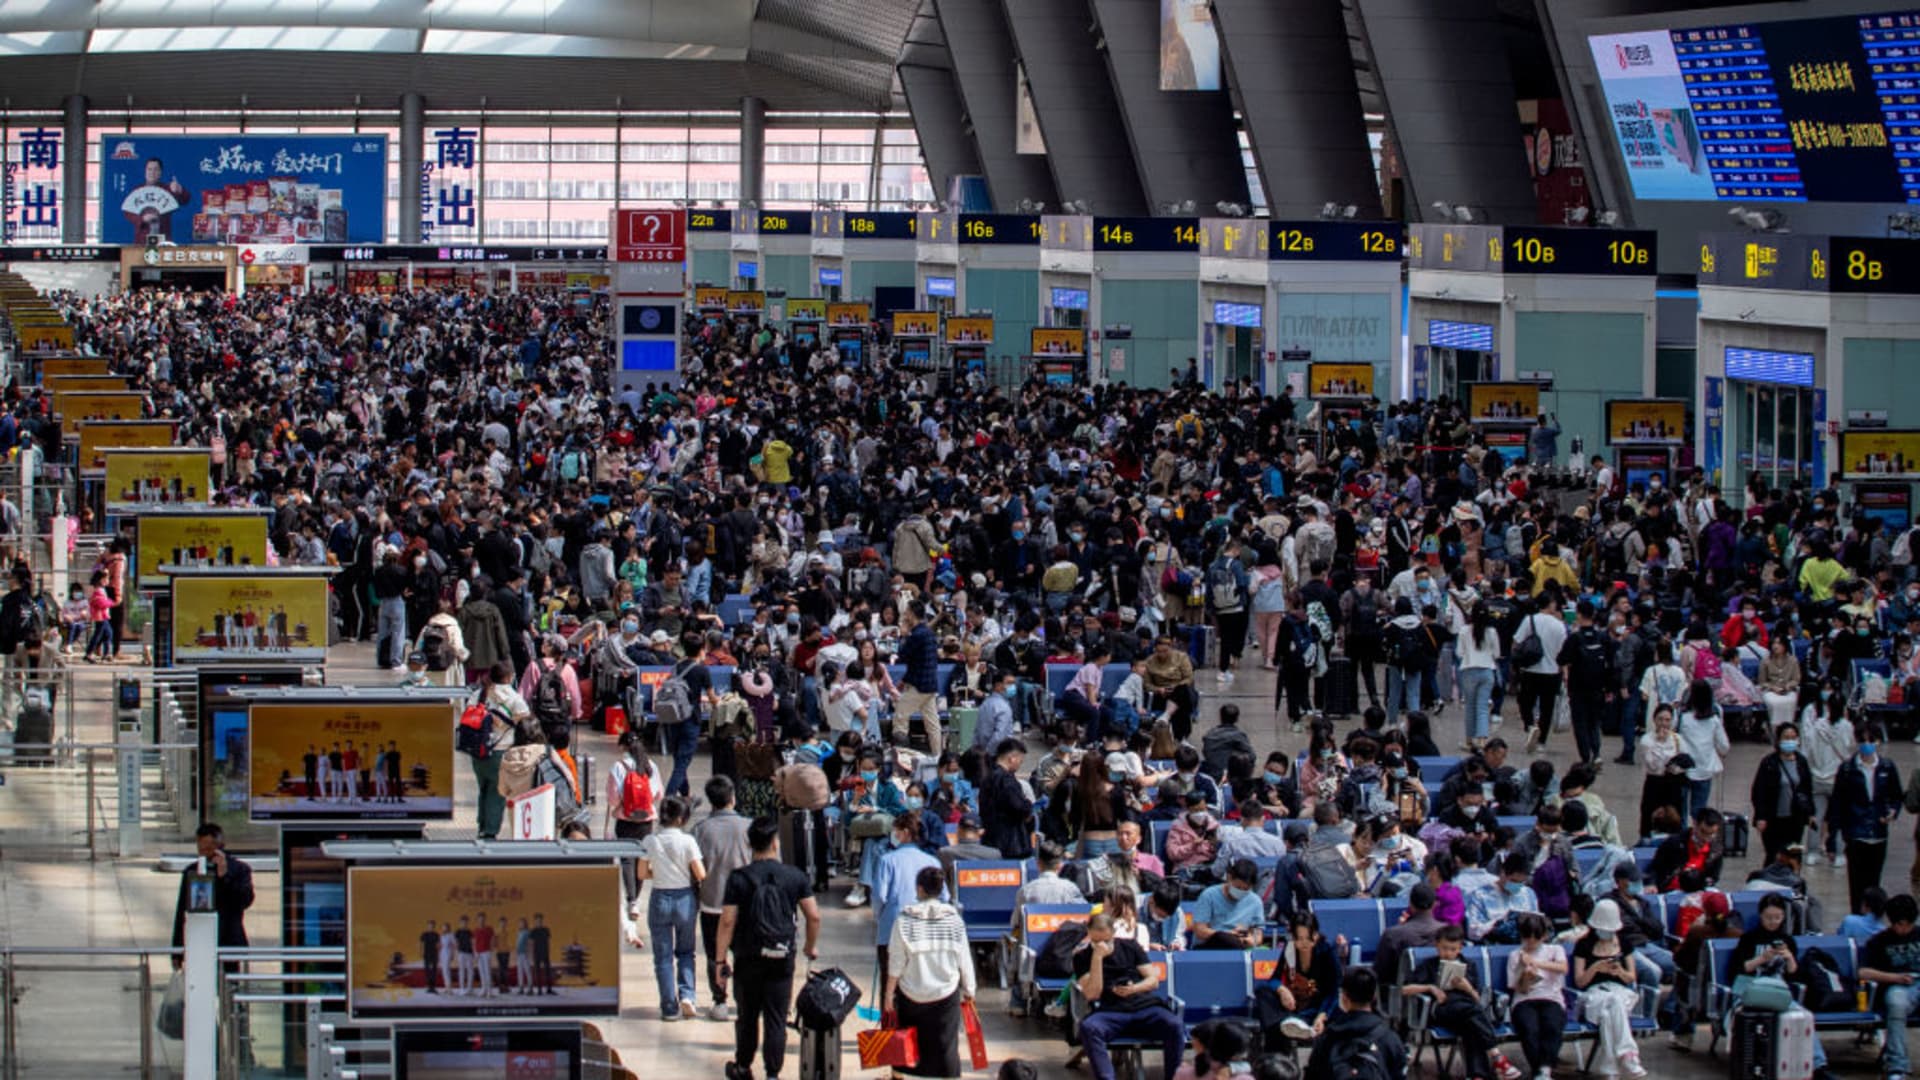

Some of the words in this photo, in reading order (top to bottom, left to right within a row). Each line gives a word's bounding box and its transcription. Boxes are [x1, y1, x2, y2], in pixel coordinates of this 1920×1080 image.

[5, 161, 18, 215] South
[19, 127, 61, 227] 南出
[421, 161, 433, 213] South
[434, 127, 477, 227] 南出
[851, 219, 875, 232] 18B
[966, 221, 993, 237] 16B
[1102, 225, 1132, 243] 14B
[1278, 230, 1313, 251] 12B
[1361, 232, 1394, 252] 12B
[1513, 238, 1555, 263] 10B
[629, 251, 674, 260] 12306
[1609, 241, 1648, 263] 10B
[1848, 250, 1882, 280] 8B
